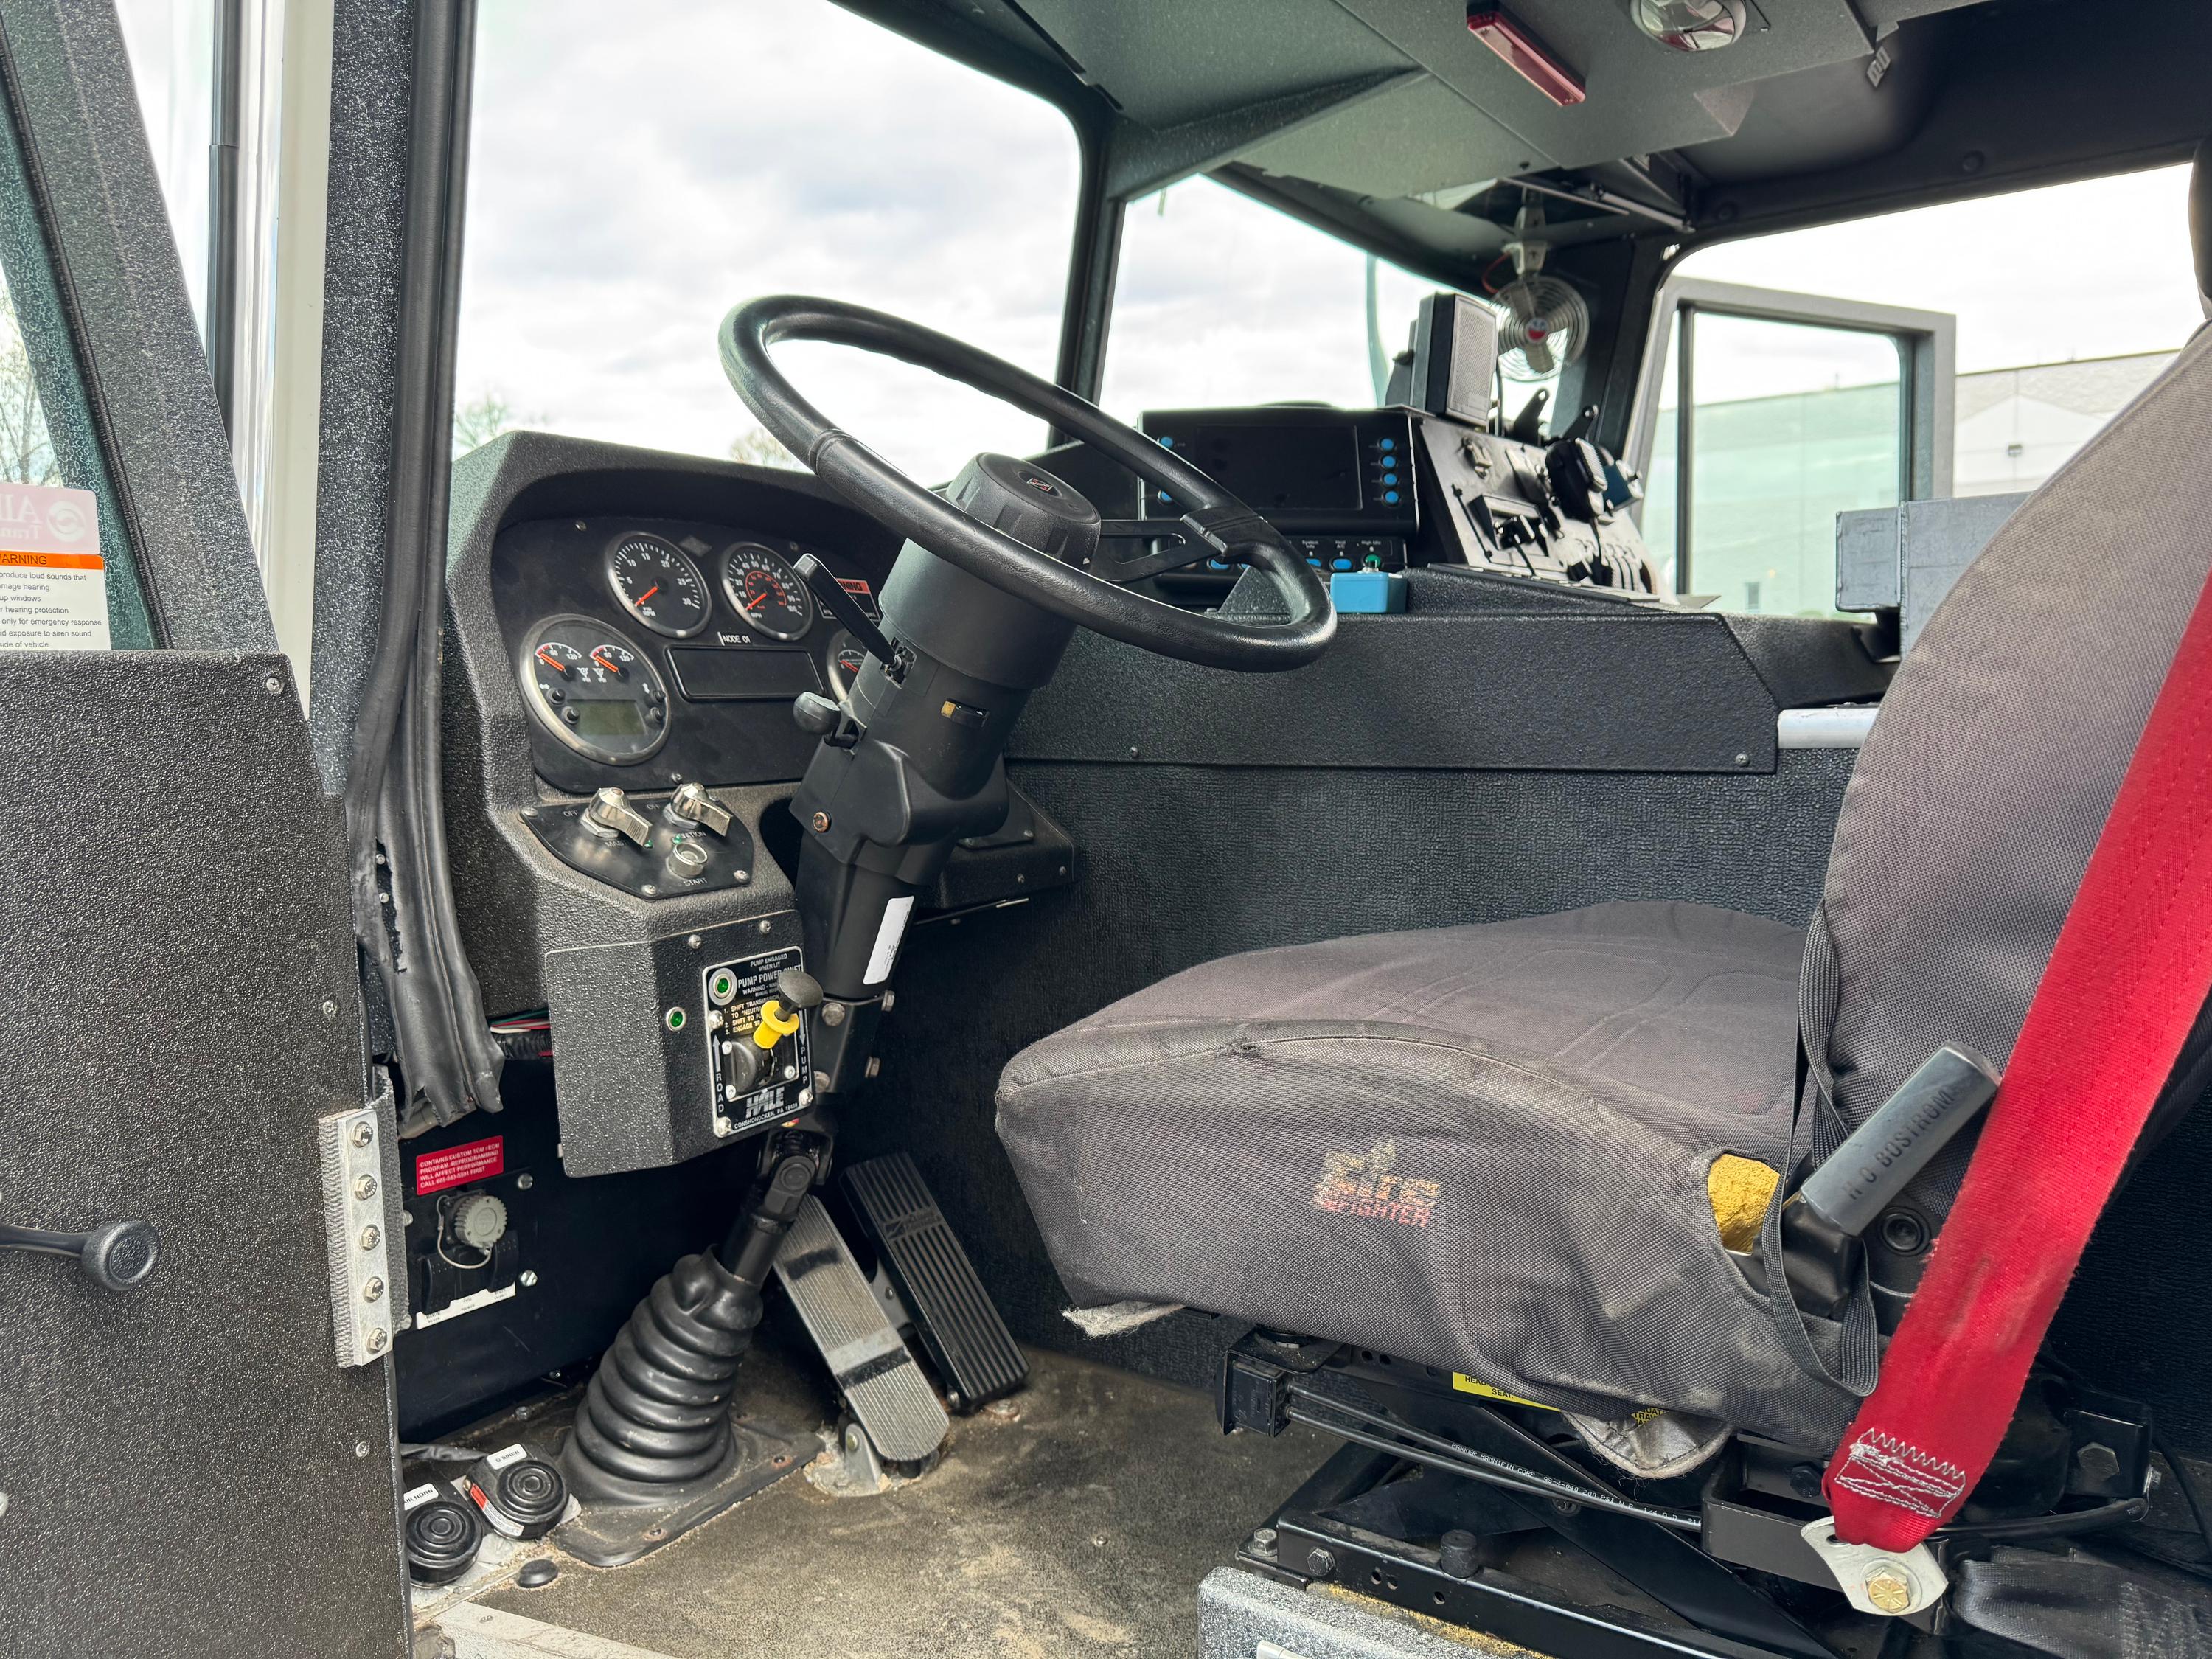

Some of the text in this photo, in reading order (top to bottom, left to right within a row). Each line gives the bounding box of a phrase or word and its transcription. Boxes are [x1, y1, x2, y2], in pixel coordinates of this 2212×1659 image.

[0, 554, 47, 565] ARNING
[641, 552, 651, 560] 15
[627, 559, 636, 567] 10
[661, 560, 670, 568] 20
[773, 571, 782, 580] 70
[677, 577, 686, 585] 25
[841, 581, 863, 591] NING
[0, 583, 50, 592] mage hearing
[738, 591, 747, 599] 10
[5, 606, 32, 614] hearing
[1, 617, 17, 626] only
[18, 617, 29, 625] for
[722, 634, 742, 644] NODE
[566, 653, 578, 661] 120
[563, 810, 579, 818] OFF
[683, 877, 708, 886] START
[750, 953, 787, 967] PUMP ENGAGED
[758, 963, 773, 972] WHEN
[738, 975, 757, 989] PUMP
[742, 984, 766, 995] WARNING
[731, 1003, 745, 1012] SHIFT
[732, 1018, 745, 1026] SHIFT
[732, 1023, 753, 1033] ENGAGE
[716, 1072, 725, 1113] ROAD
[745, 1085, 785, 1119] HALE
[1875, 1088, 1955, 1169] BOSTROM
[420, 1155, 448, 1168] CONTAINS
[448, 1149, 473, 1161] CUSTOM
[473, 1146, 484, 1155] TCM
[451, 1150, 499, 1166] REPROGRAMMING
[420, 1156, 498, 1182] WILL AFFECT PERFORMANCE
[420, 1180, 435, 1189] CALL
[470, 1166, 486, 1175] FIRST
[501, 1450, 520, 1461] SIREN
[1451, 1442, 1477, 1458] PARKER
[1480, 1454, 1514, 1471] HANNIFIN
[1517, 1467, 1536, 1477] CORP
[1582, 1489, 1598, 1499] 200
[1600, 1494, 1615, 1504] PSI
[414, 1488, 434, 1501] HORN
